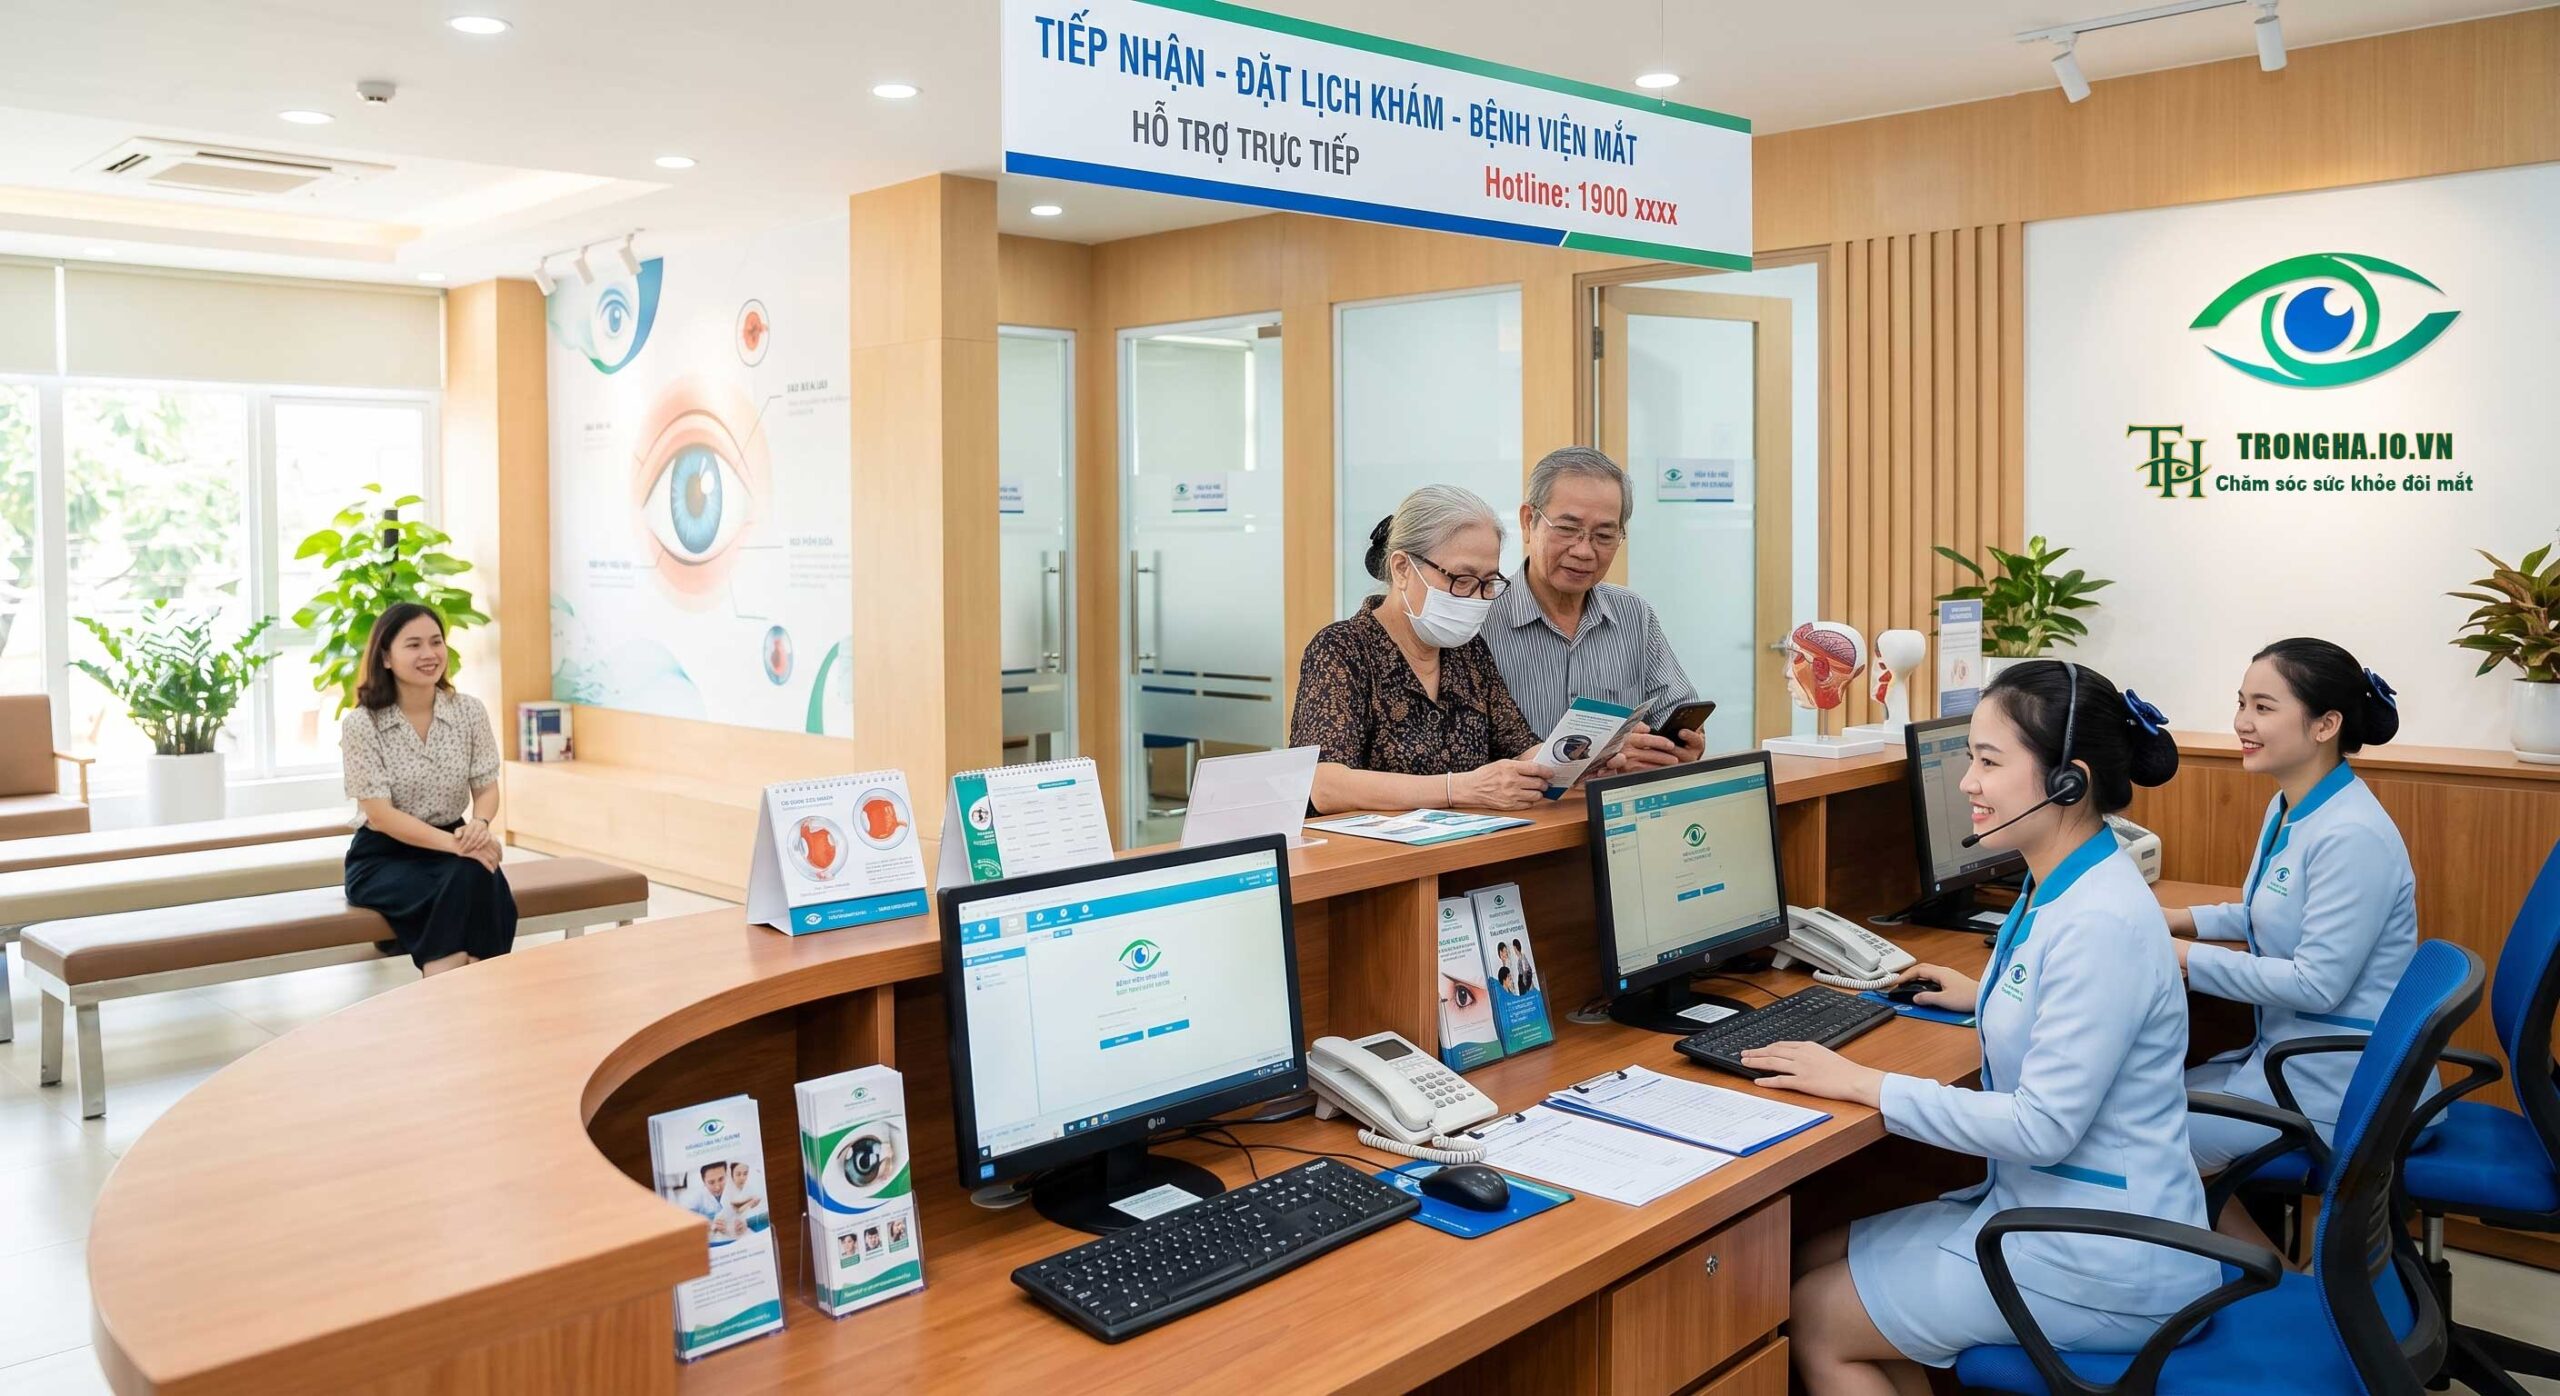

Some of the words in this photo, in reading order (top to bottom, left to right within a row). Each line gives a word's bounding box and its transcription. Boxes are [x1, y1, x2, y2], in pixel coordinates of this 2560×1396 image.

[1034, 11, 1108, 68] TIẾP
[1119, 32, 1205, 92] NHẬN
[1215, 70, 1227, 79] -
[1236, 51, 1292, 109] ĐẶT
[1301, 69, 1361, 118] LỊCH
[1371, 82, 1444, 132] KHÁM
[1452, 115, 1462, 124] -
[1469, 97, 1530, 149] BỆNH
[1537, 112, 1587, 162] VIỆN
[1594, 119, 1638, 166] MẮT
[1132, 100, 1169, 148] HỖ
[1177, 117, 1229, 164] TRỢ
[1236, 126, 1302, 173] TRỰC
[1309, 132, 1360, 176] TIẾP
[1485, 165, 1570, 209] Hotline:
[1579, 181, 1628, 218] 1900
[1635, 197, 1678, 226] xxxx
[2236, 432, 2453, 460] TRONGHA.IO.VN
[2215, 474, 2269, 492] Chăm
[2275, 474, 2307, 492] sóc
[2313, 473, 2345, 492] sức
[2351, 472, 2397, 492] khỏe
[2402, 474, 2431, 492] đôi
[2437, 471, 2474, 492] mắt
